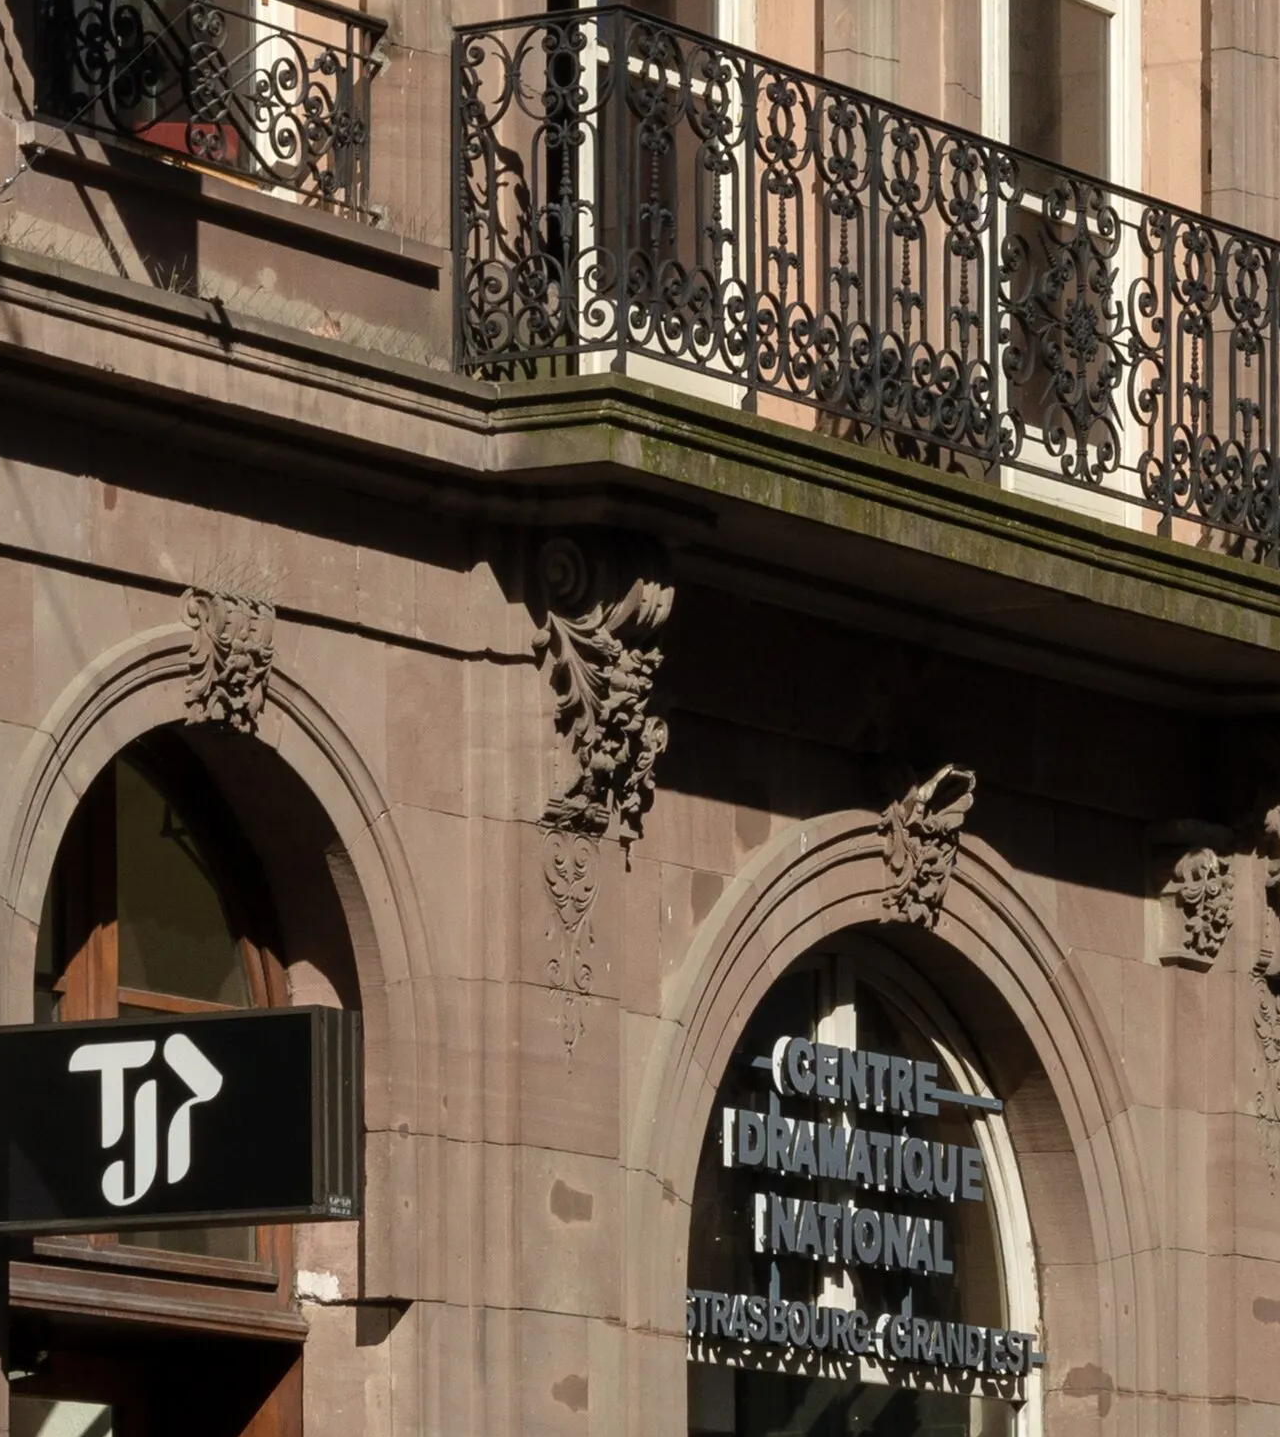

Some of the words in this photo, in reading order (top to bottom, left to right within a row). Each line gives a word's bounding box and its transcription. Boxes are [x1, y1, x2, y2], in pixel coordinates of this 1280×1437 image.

[778, 1035, 939, 1117] CENTRE
[734, 1108, 985, 1202] DRAMATIQUE
[766, 1191, 954, 1275] NATIONAL
[886, 1314, 986, 1369] GRAND
[987, 1328, 1037, 1375] EST
